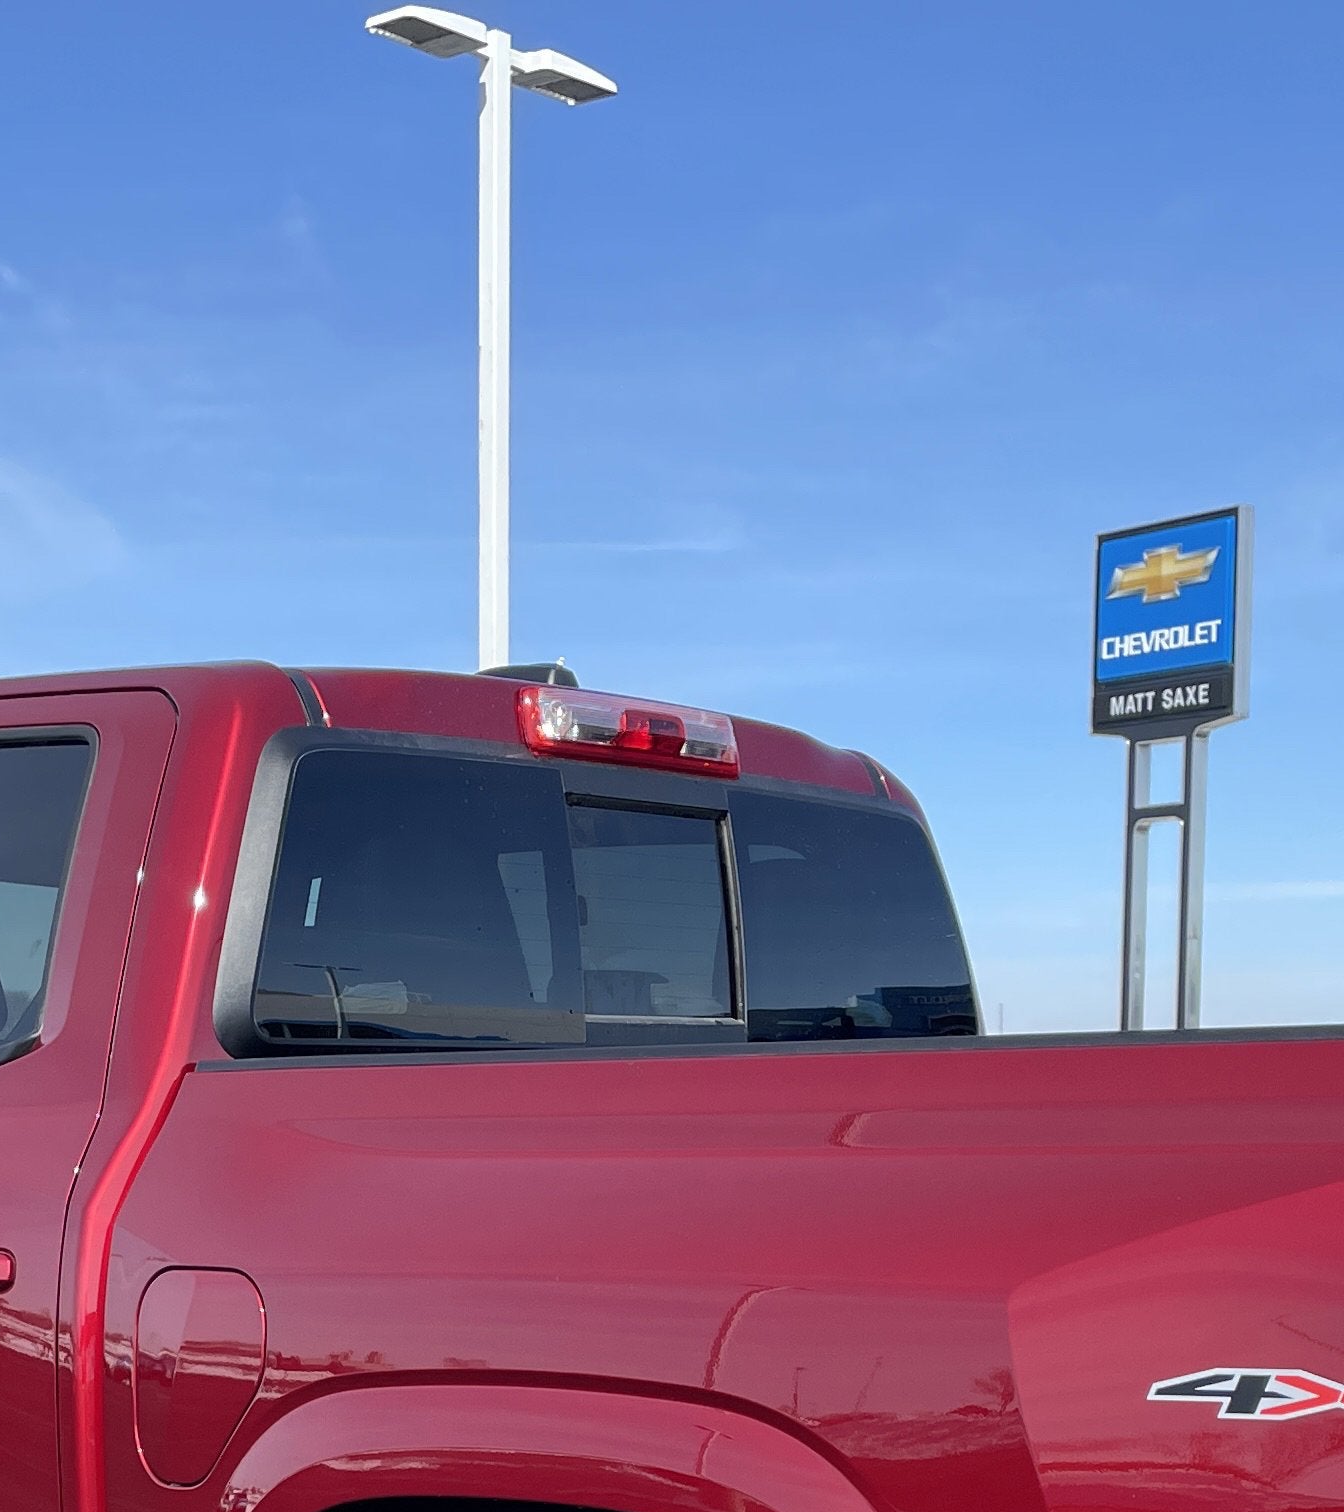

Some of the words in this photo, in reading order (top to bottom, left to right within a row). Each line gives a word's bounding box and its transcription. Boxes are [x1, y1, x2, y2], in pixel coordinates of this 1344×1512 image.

[1101, 619, 1221, 660] CHEVROLET
[1109, 690, 1156, 717] MATT
[1161, 683, 1210, 711] SAXE
